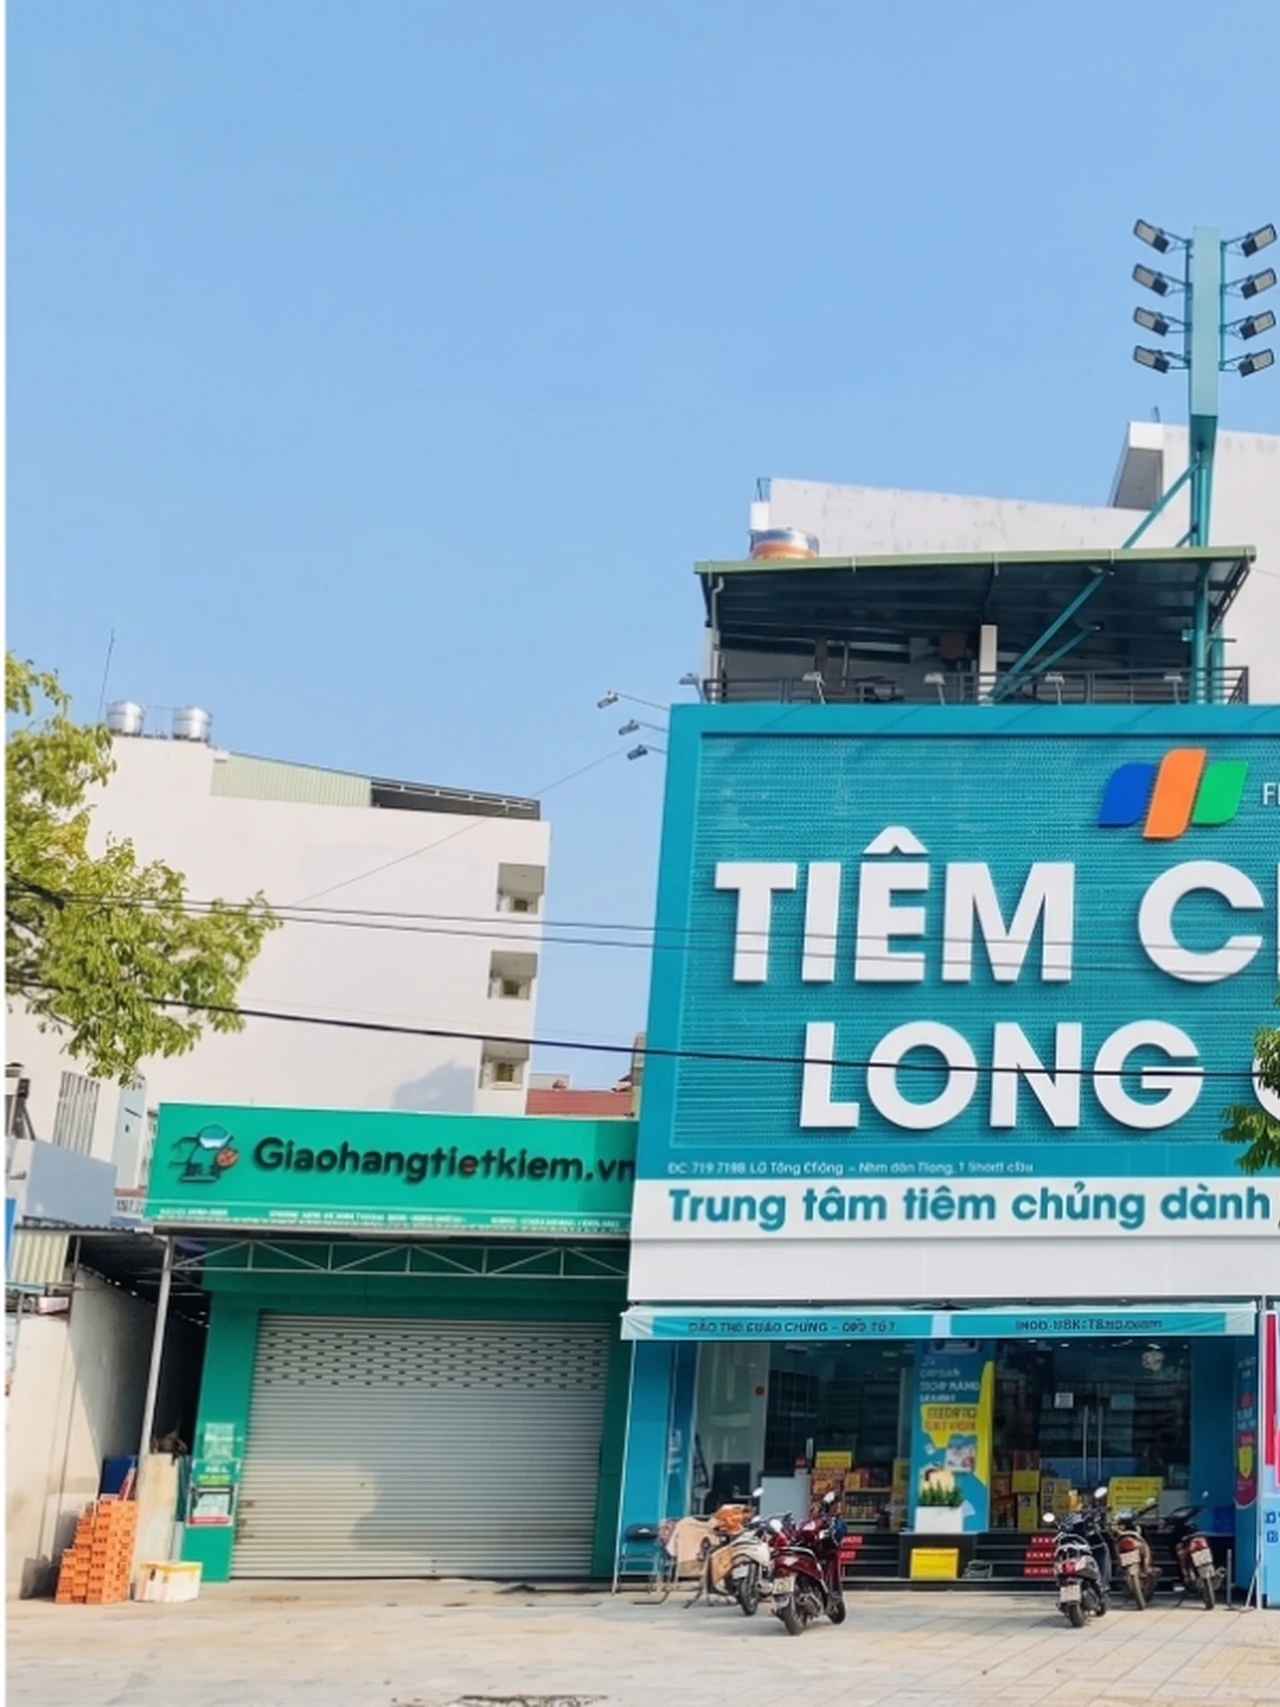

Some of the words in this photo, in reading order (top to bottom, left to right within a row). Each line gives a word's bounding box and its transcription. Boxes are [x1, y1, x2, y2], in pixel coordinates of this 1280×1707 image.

[714, 825, 1076, 983] TIÊM
[799, 1020, 1204, 1129] LONG
[668, 1188, 787, 1232] Trung
[802, 1185, 887, 1222] tâm
[903, 1185, 996, 1221] tiêm
[1011, 1181, 1146, 1231] chủng
[1160, 1184, 1271, 1221] dành
